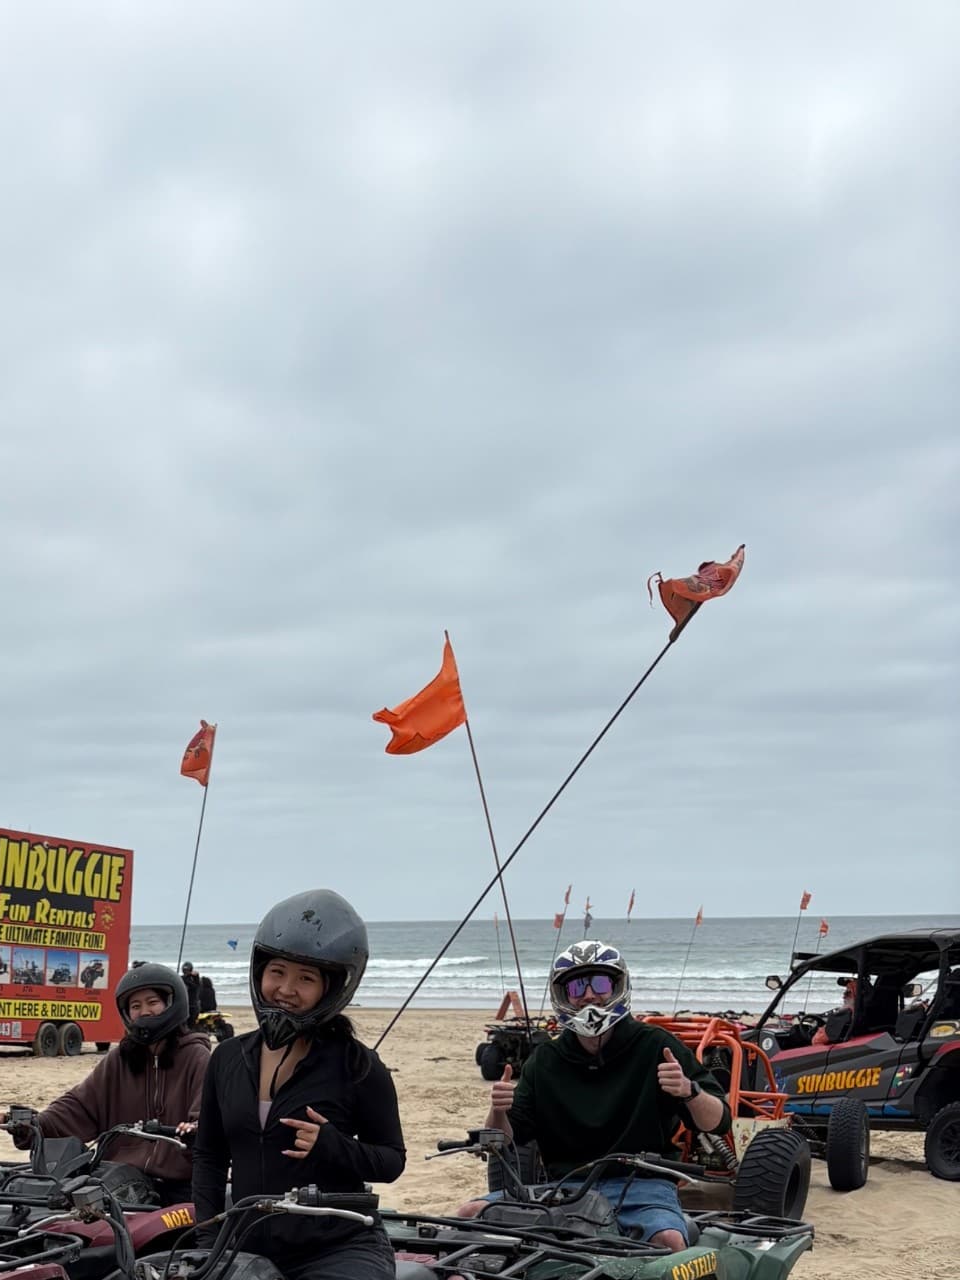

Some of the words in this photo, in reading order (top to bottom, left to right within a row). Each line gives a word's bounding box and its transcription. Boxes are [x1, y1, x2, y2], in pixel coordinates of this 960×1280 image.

[5, 926, 48, 944] ULTIMATE
[50, 930, 80, 947] FAMILY
[83, 932, 103, 949] FUN!
[14, 1002, 39, 1017] HERE
[41, 1004, 49, 1017] &
[51, 1004, 72, 1018] RIDE
[74, 1005, 99, 1018] NOW
[796, 1067, 883, 1094] SUNBUGGIE
[161, 1208, 193, 1229] NOEL
